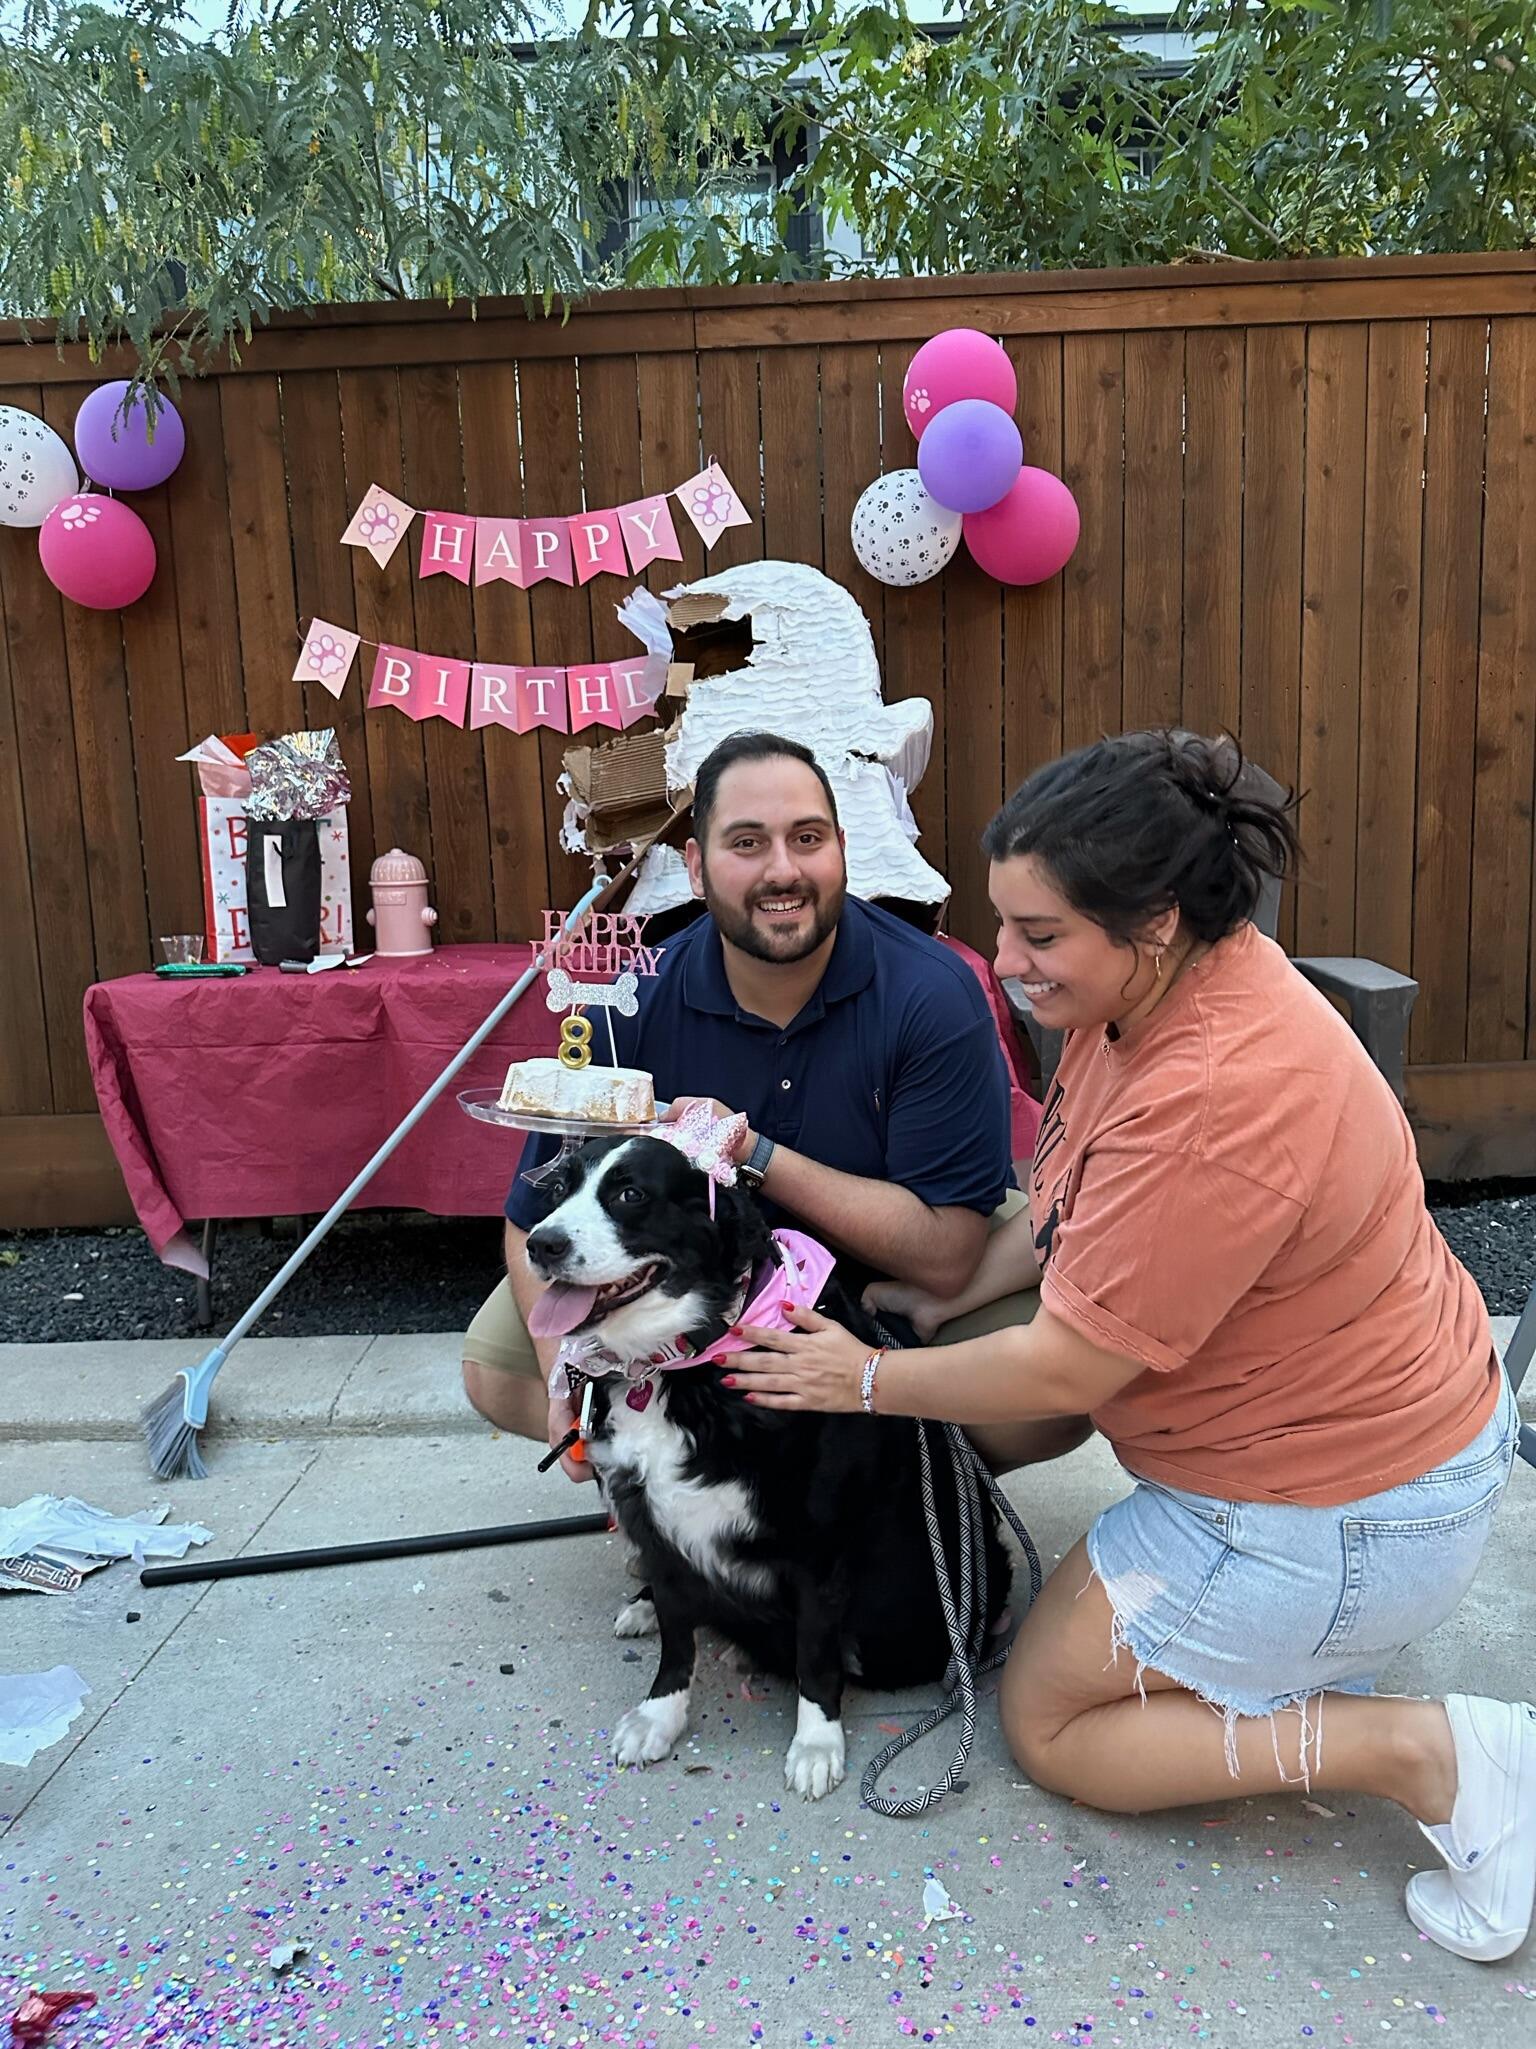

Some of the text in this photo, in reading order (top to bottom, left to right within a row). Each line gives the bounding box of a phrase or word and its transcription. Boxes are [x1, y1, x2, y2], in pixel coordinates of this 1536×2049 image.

[429, 507, 664, 569] HAPPY
[541, 910, 653, 947] HAPPY
[529, 940, 666, 976] BIRTHDAY
[558, 1015, 593, 1070] 8
